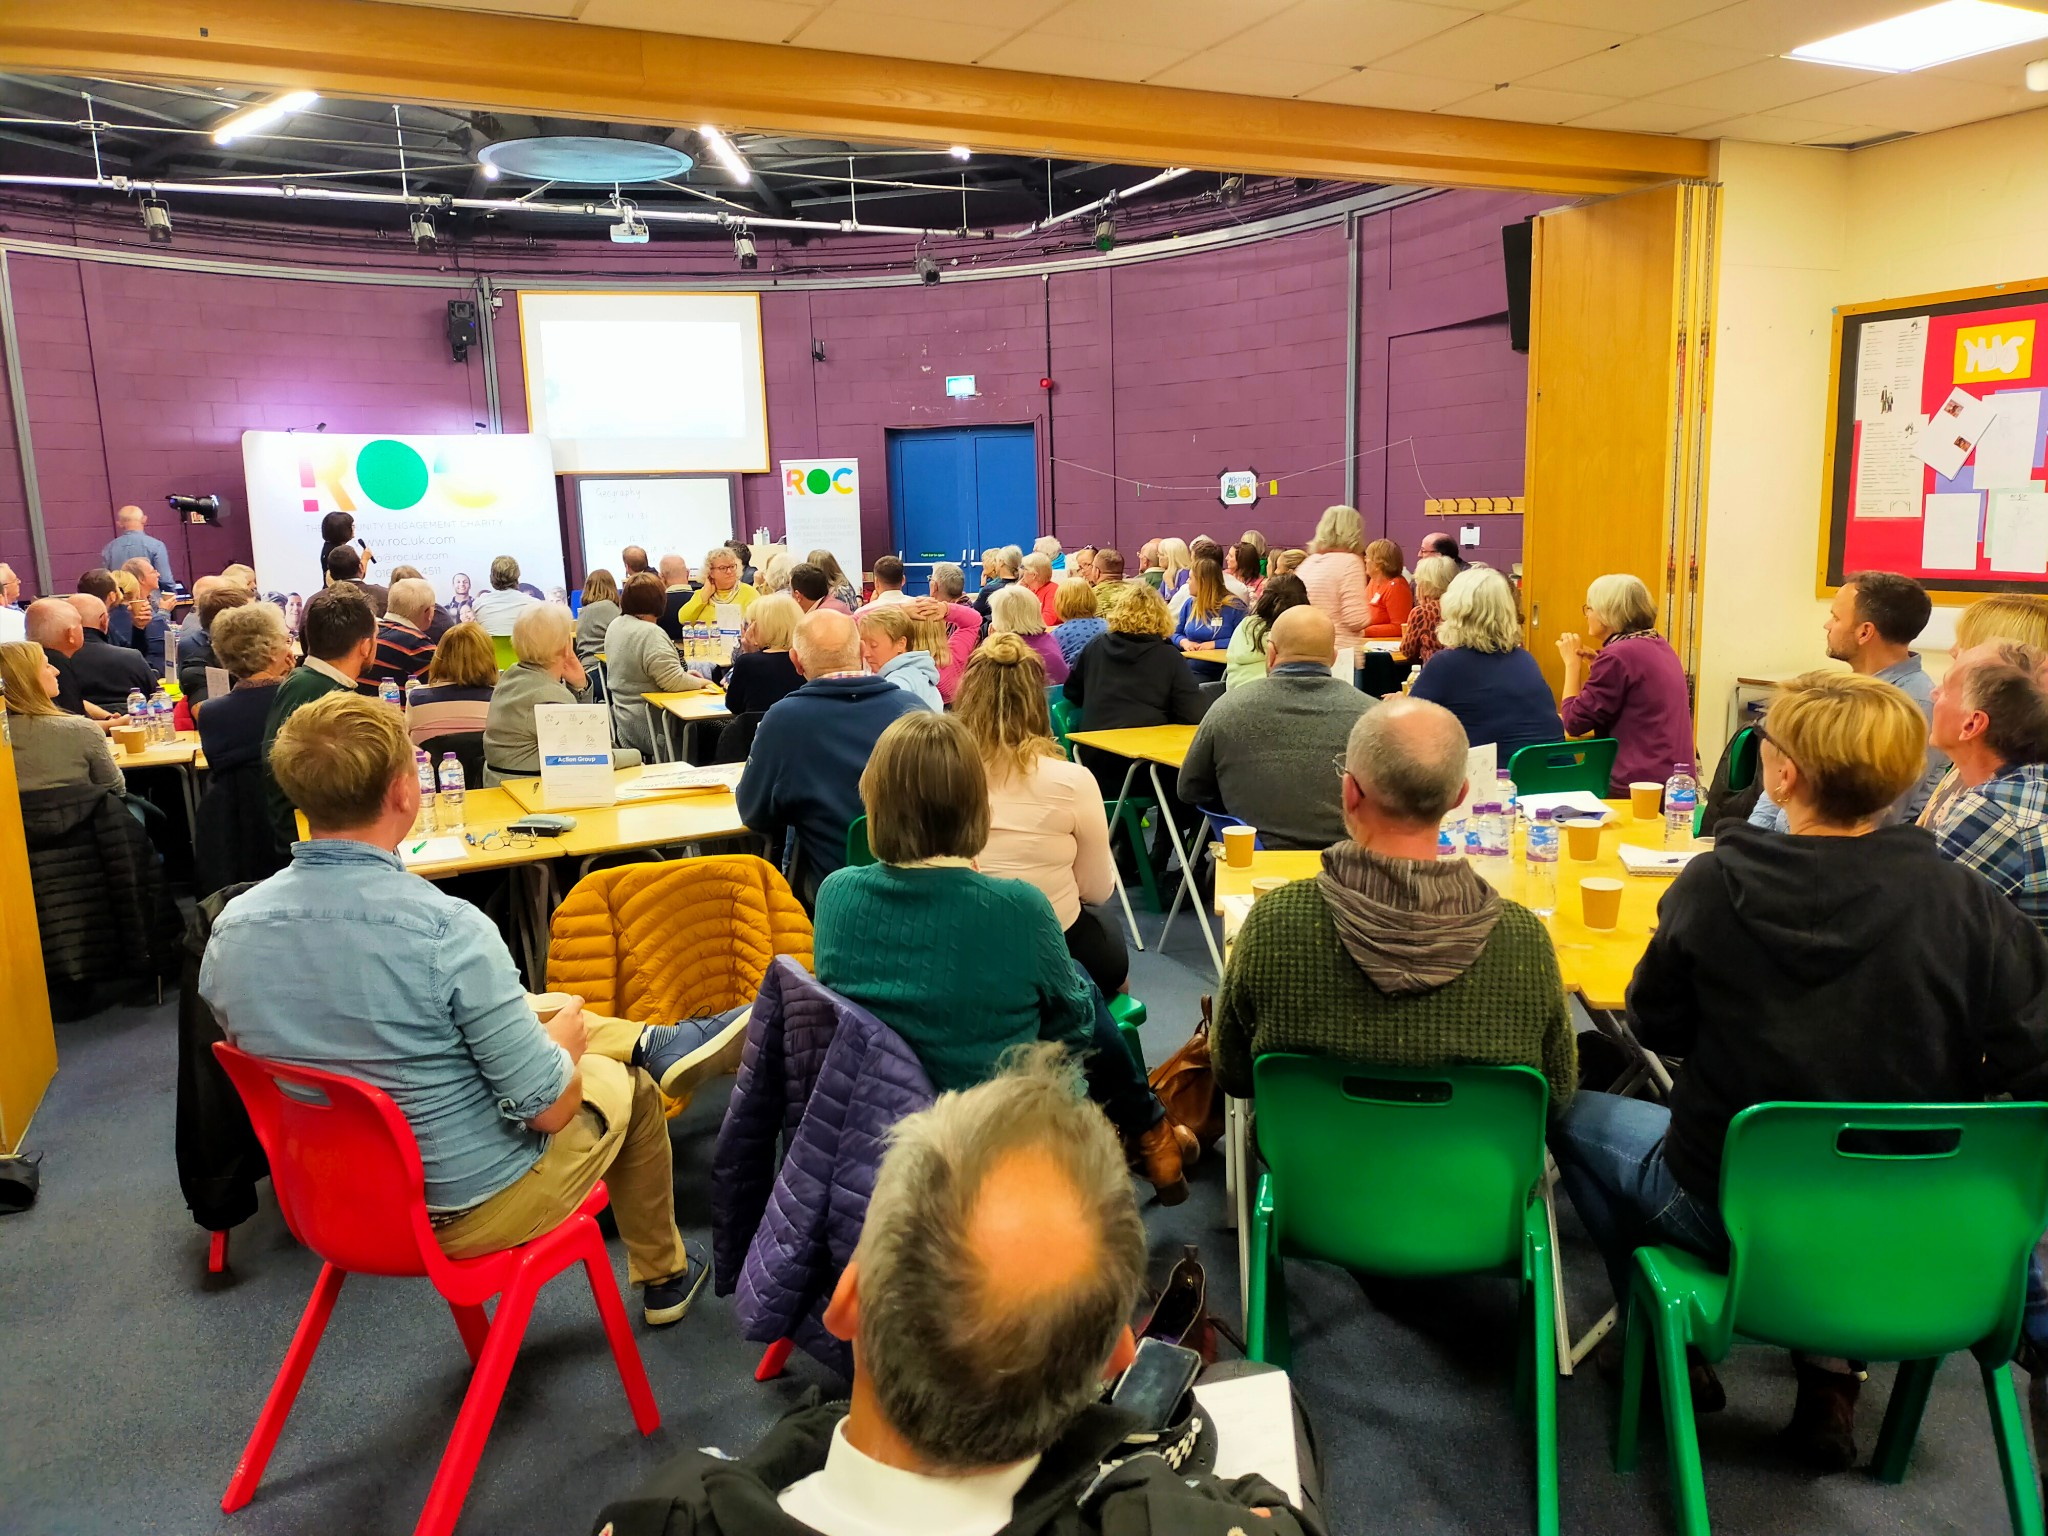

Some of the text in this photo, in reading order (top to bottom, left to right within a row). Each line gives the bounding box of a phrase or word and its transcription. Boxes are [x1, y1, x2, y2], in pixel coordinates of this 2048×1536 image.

[786, 467, 854, 495] ROC
[388, 520, 457, 530] ENGAGEMENT
[460, 519, 503, 528] CHARITY
[376, 552, 449, 563] o@roc.uk.com
[374, 566, 442, 578] 016 4511
